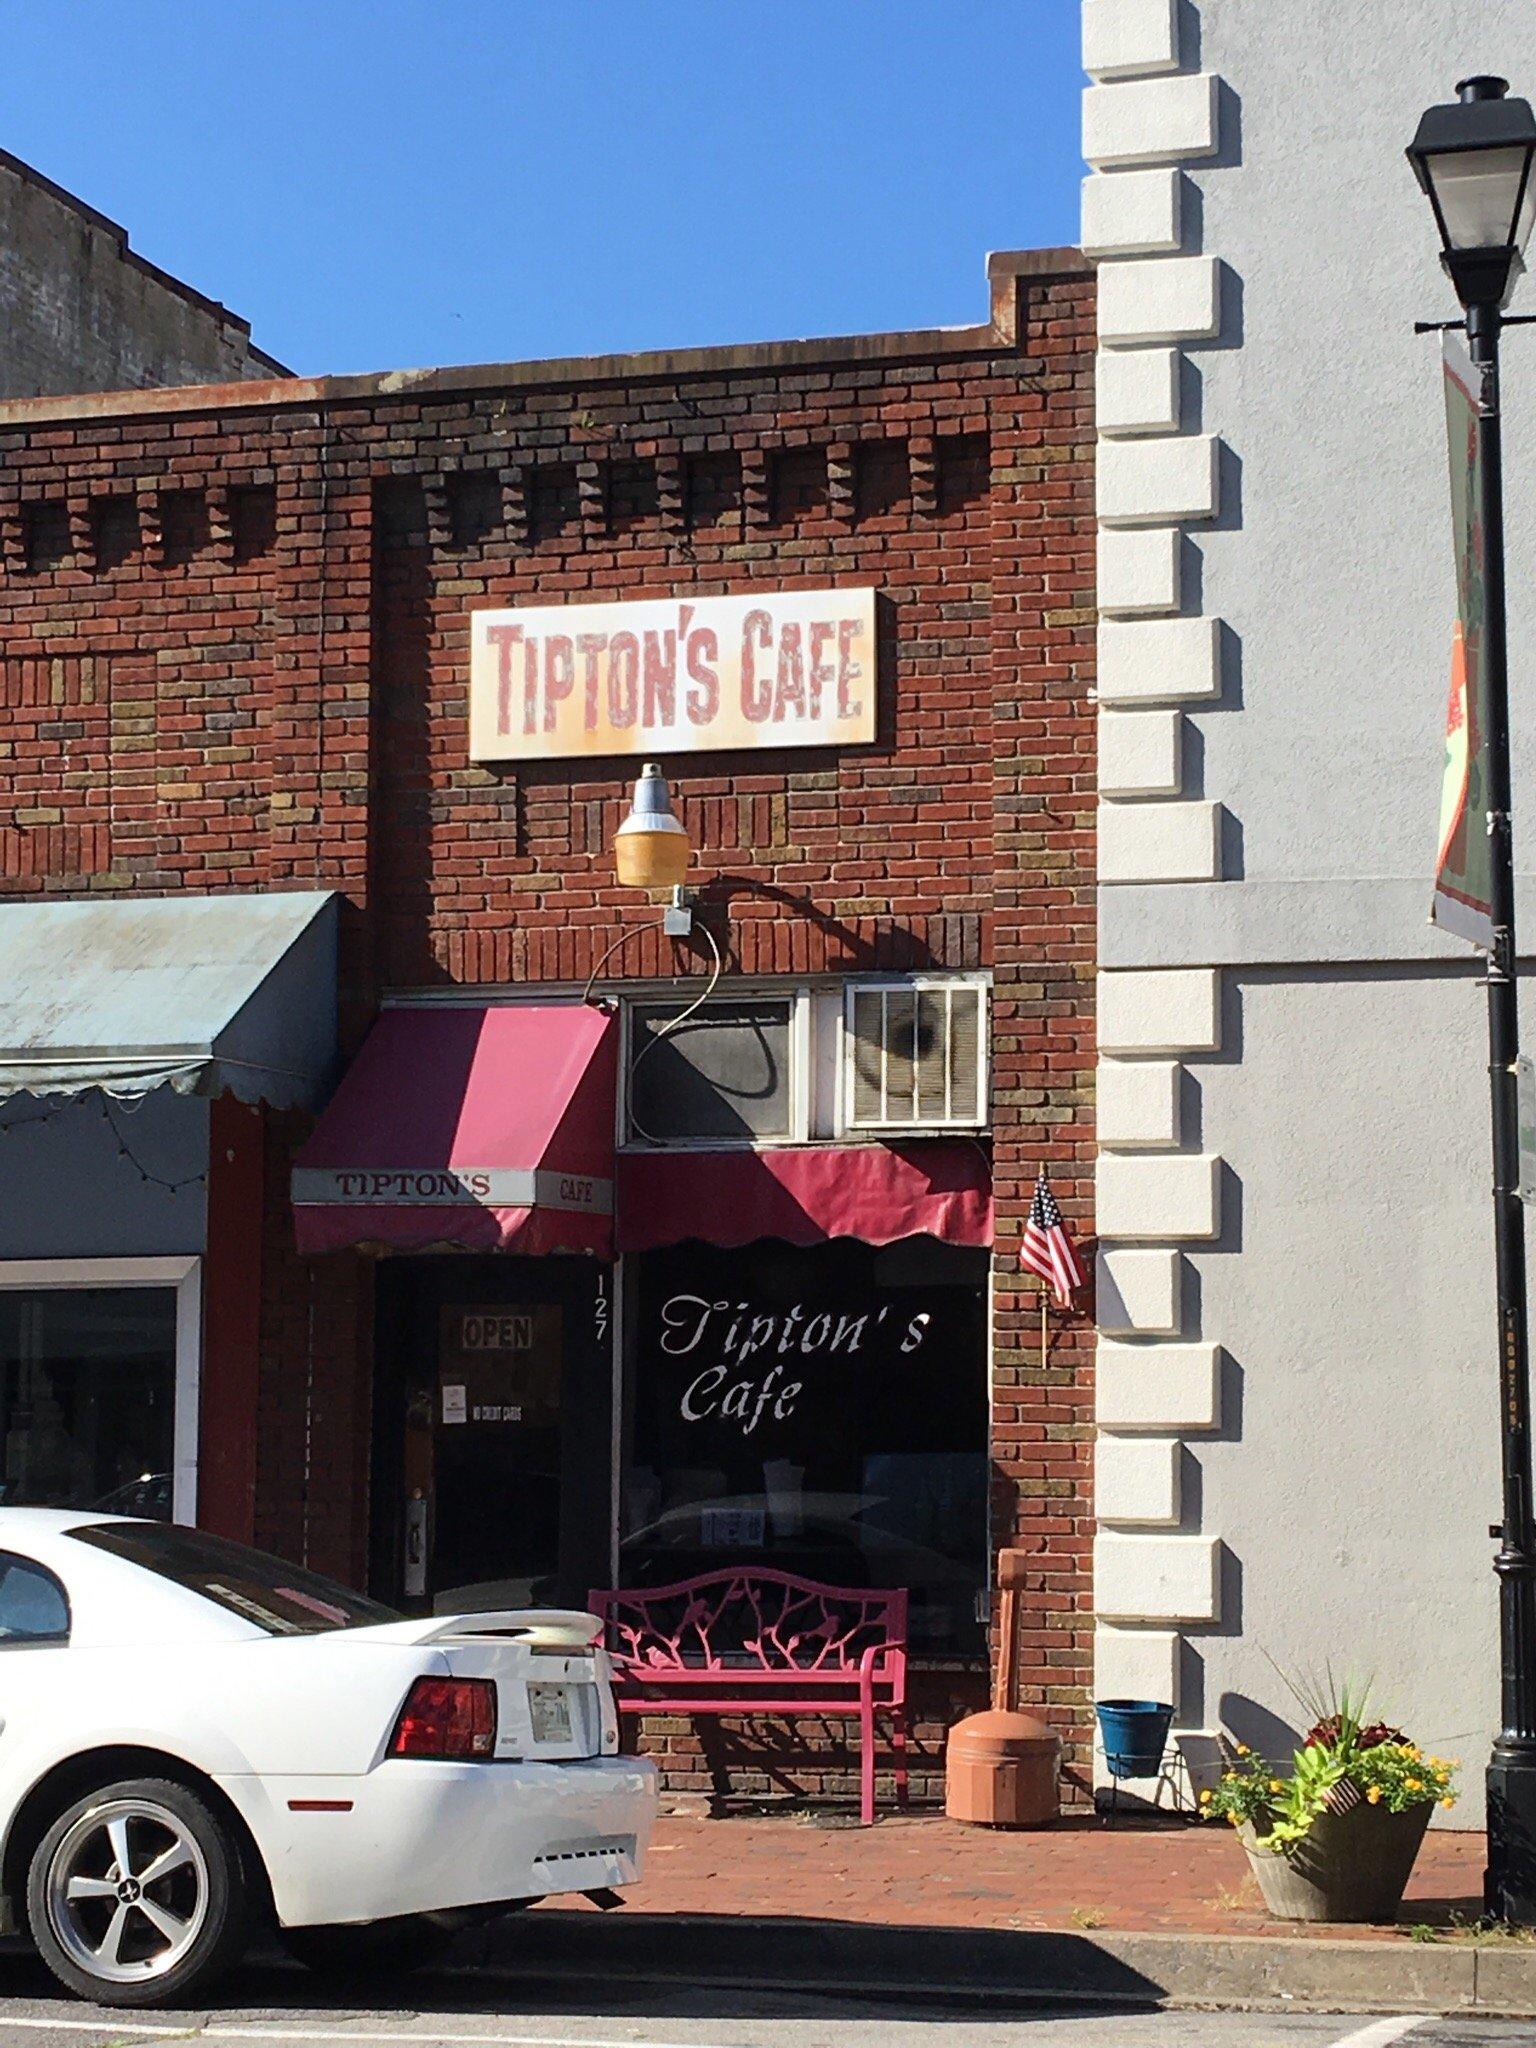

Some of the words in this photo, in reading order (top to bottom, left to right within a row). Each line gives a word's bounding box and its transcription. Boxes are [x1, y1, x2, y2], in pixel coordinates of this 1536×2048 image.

[741, 609, 865, 723] CAFE
[336, 1173, 490, 1196] TIPTON'S
[560, 1177, 593, 1203] CAFE
[595, 1274, 607, 1340] 127
[464, 1317, 530, 1347] OPEN
[680, 1365, 803, 1434] Cafe
